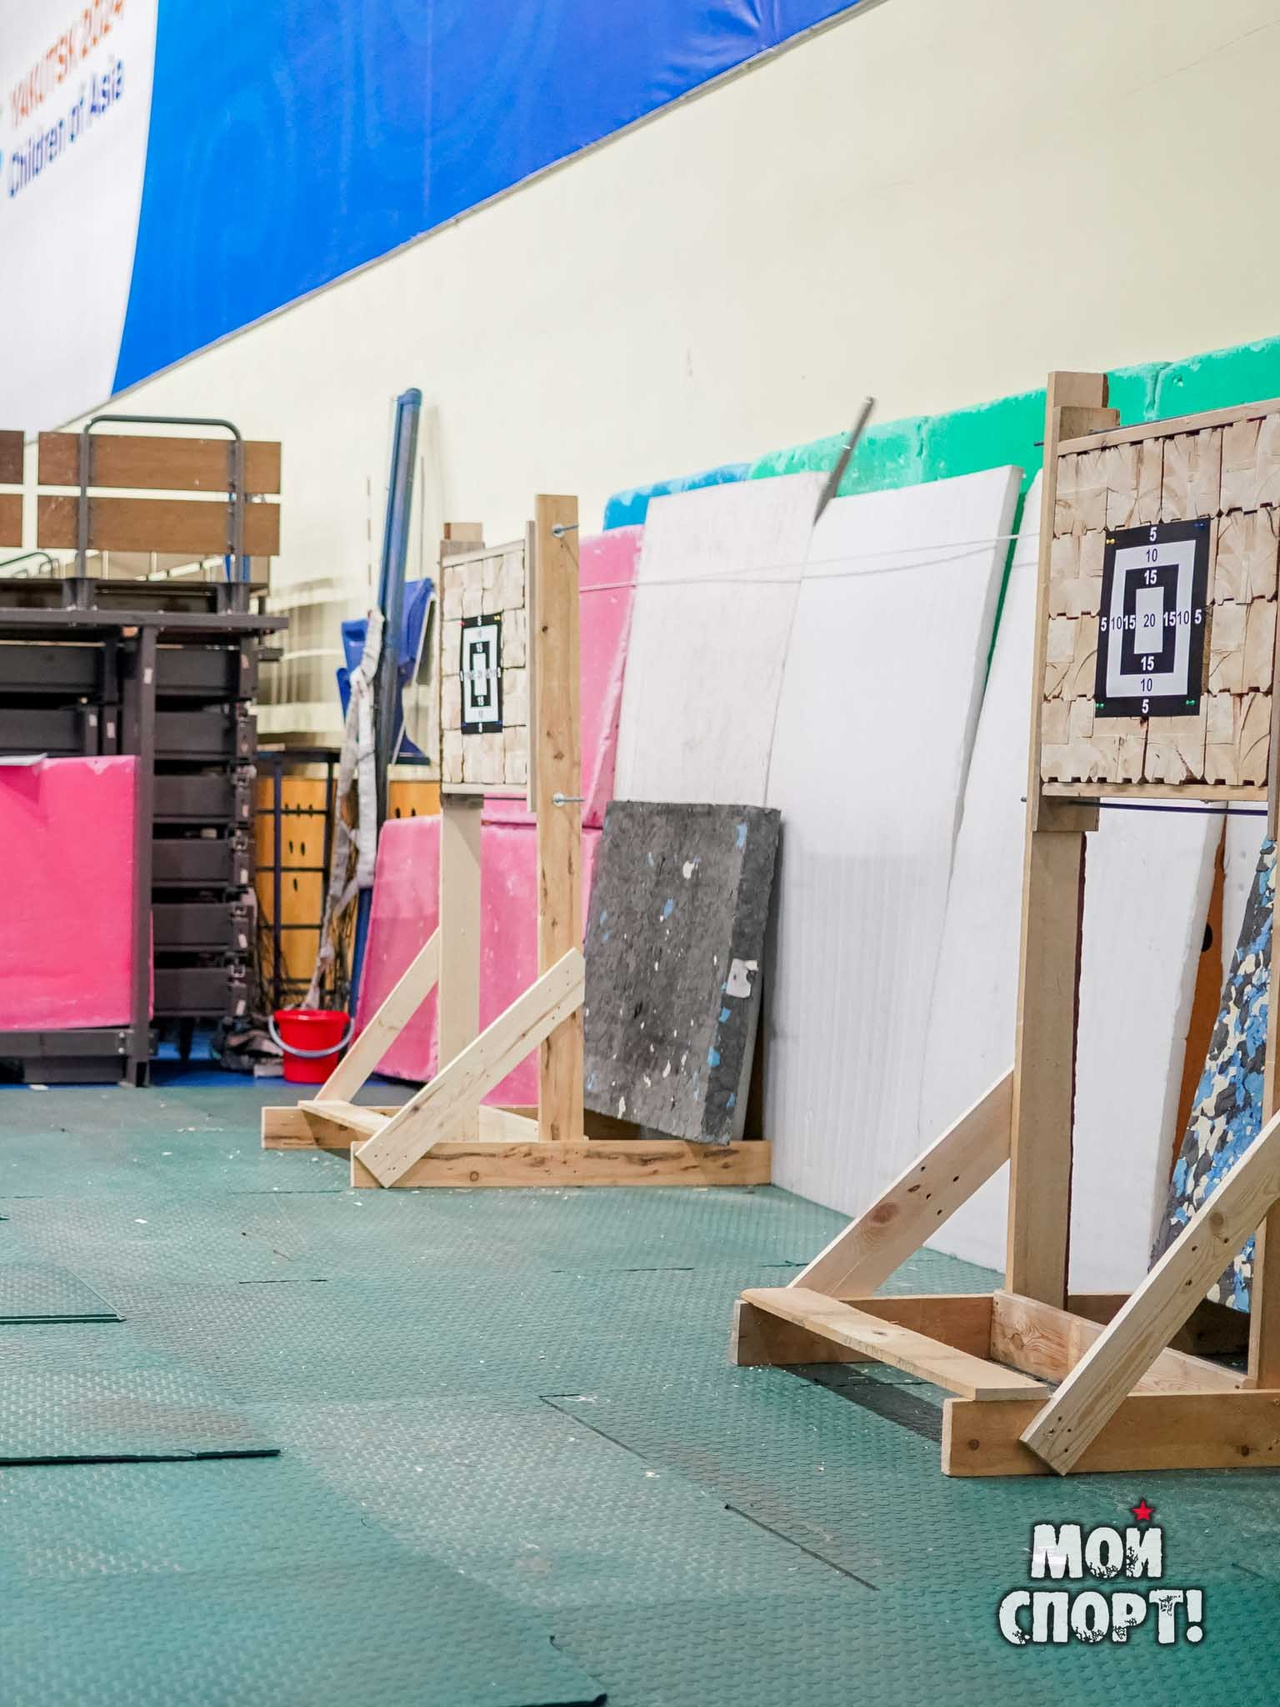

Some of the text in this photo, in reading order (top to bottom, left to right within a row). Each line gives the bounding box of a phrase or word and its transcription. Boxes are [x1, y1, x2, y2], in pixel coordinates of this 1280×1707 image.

[11, 27, 78, 129] YAKUTSK
[9, 56, 124, 198] Children of Asia
[1149, 526, 1158, 541] 5
[1146, 548, 1158, 563] 10
[1144, 570, 1157, 585] 15
[1101, 609, 1202, 631] 5 10 15 20 15 10 5
[1141, 656, 1154, 671] 15
[1141, 678, 1153, 692] 10
[1141, 699, 1149, 714] 5
